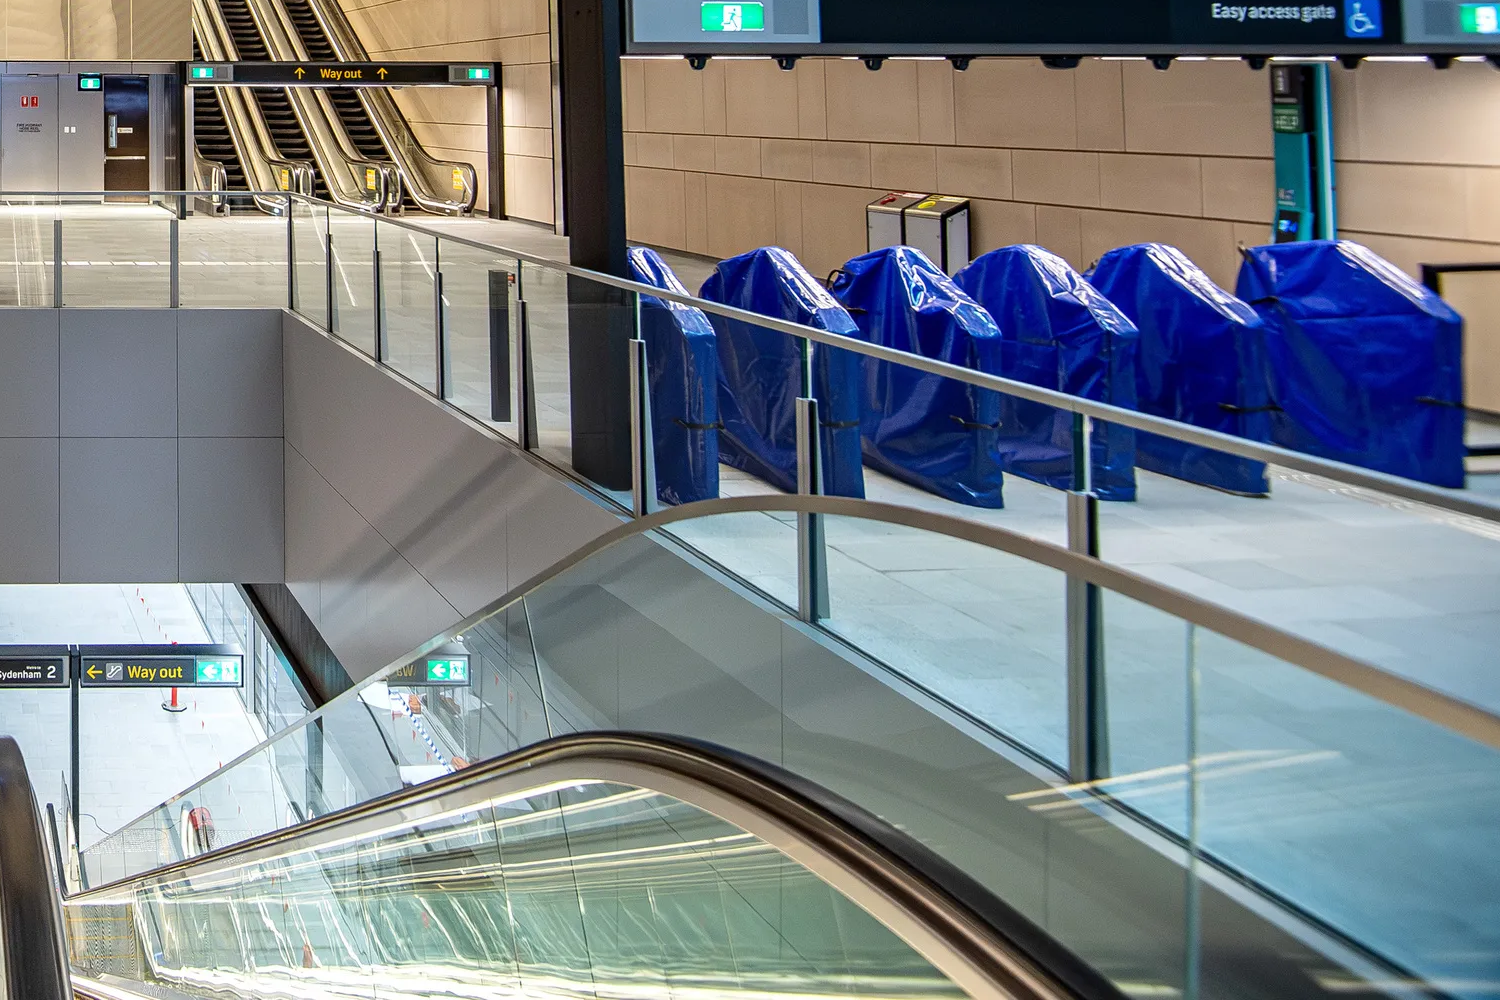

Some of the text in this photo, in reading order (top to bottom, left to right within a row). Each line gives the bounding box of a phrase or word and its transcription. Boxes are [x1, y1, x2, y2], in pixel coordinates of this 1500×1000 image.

[1211, 3, 1336, 22] Easy access gate
[320, 68, 362, 81] Way out
[47, 665, 56, 679] 2
[127, 665, 183, 681] Way out
